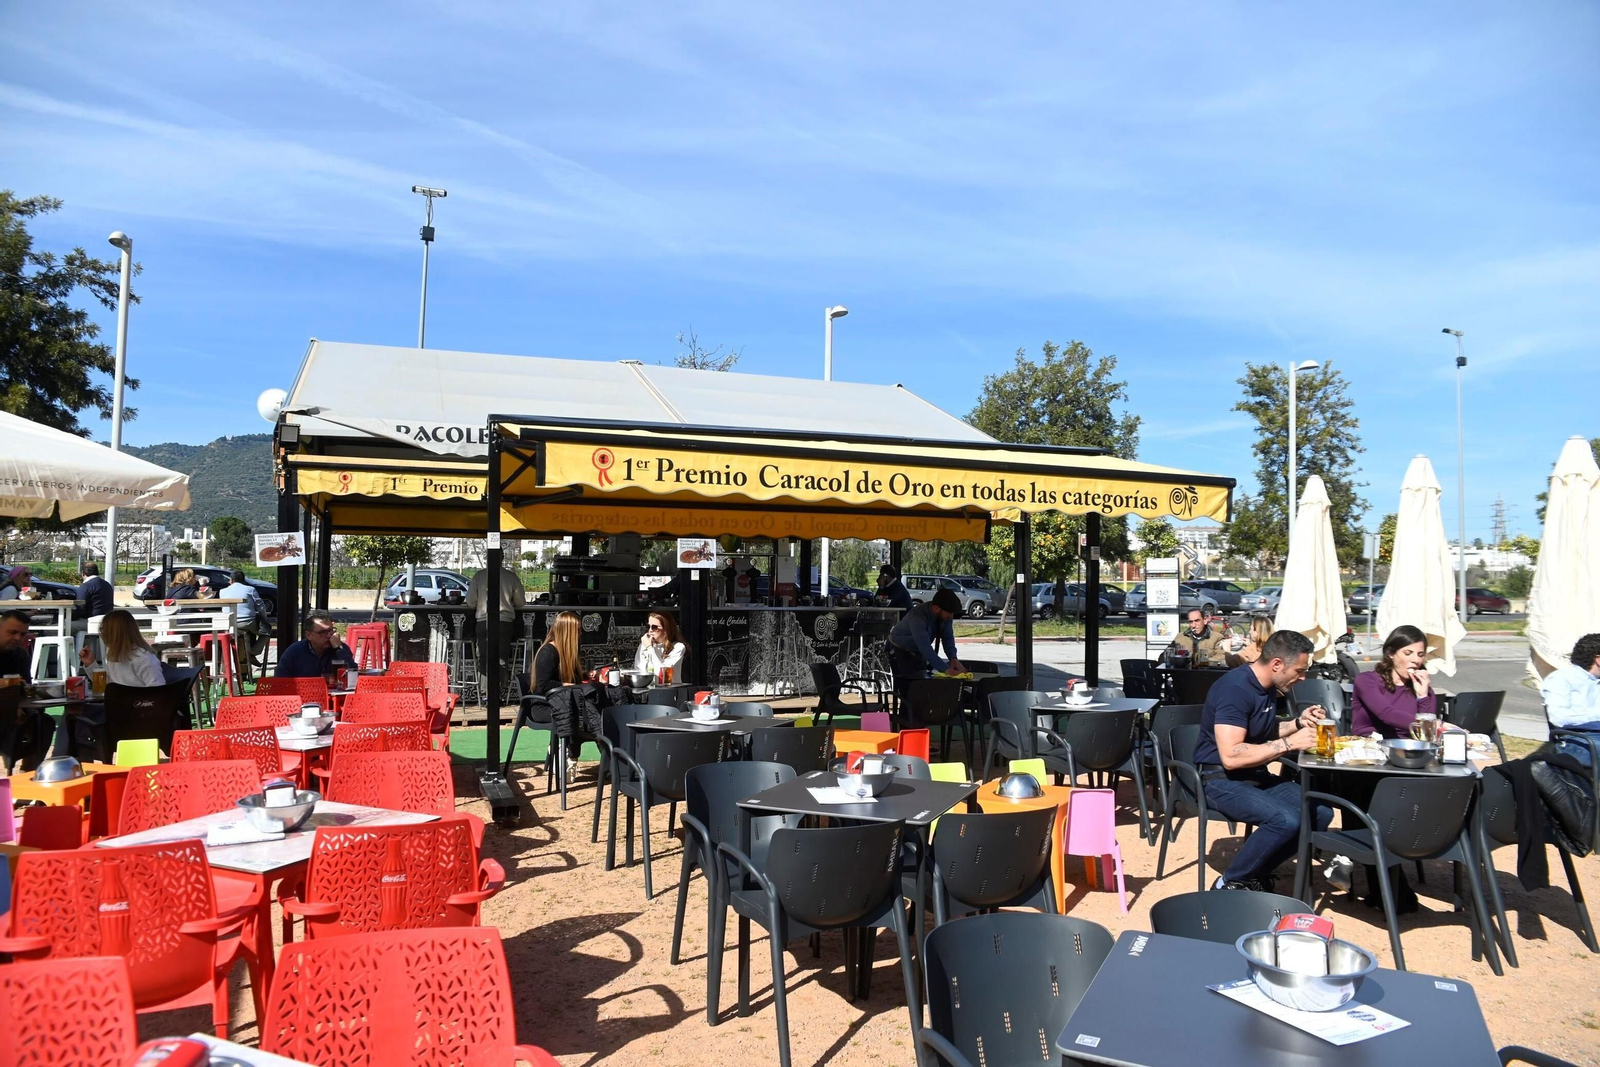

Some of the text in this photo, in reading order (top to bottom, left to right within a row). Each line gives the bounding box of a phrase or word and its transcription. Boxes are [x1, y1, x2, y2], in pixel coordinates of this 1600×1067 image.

[423, 478, 478, 495] Premio
[622, 457, 1158, 514] 1er Premio Caracol de Oro en todas las categorías
[888, 836, 899, 872] AMBAR
[381, 874, 407, 883] Coca-Cola
[99, 901, 129, 912] Coca-Cola
